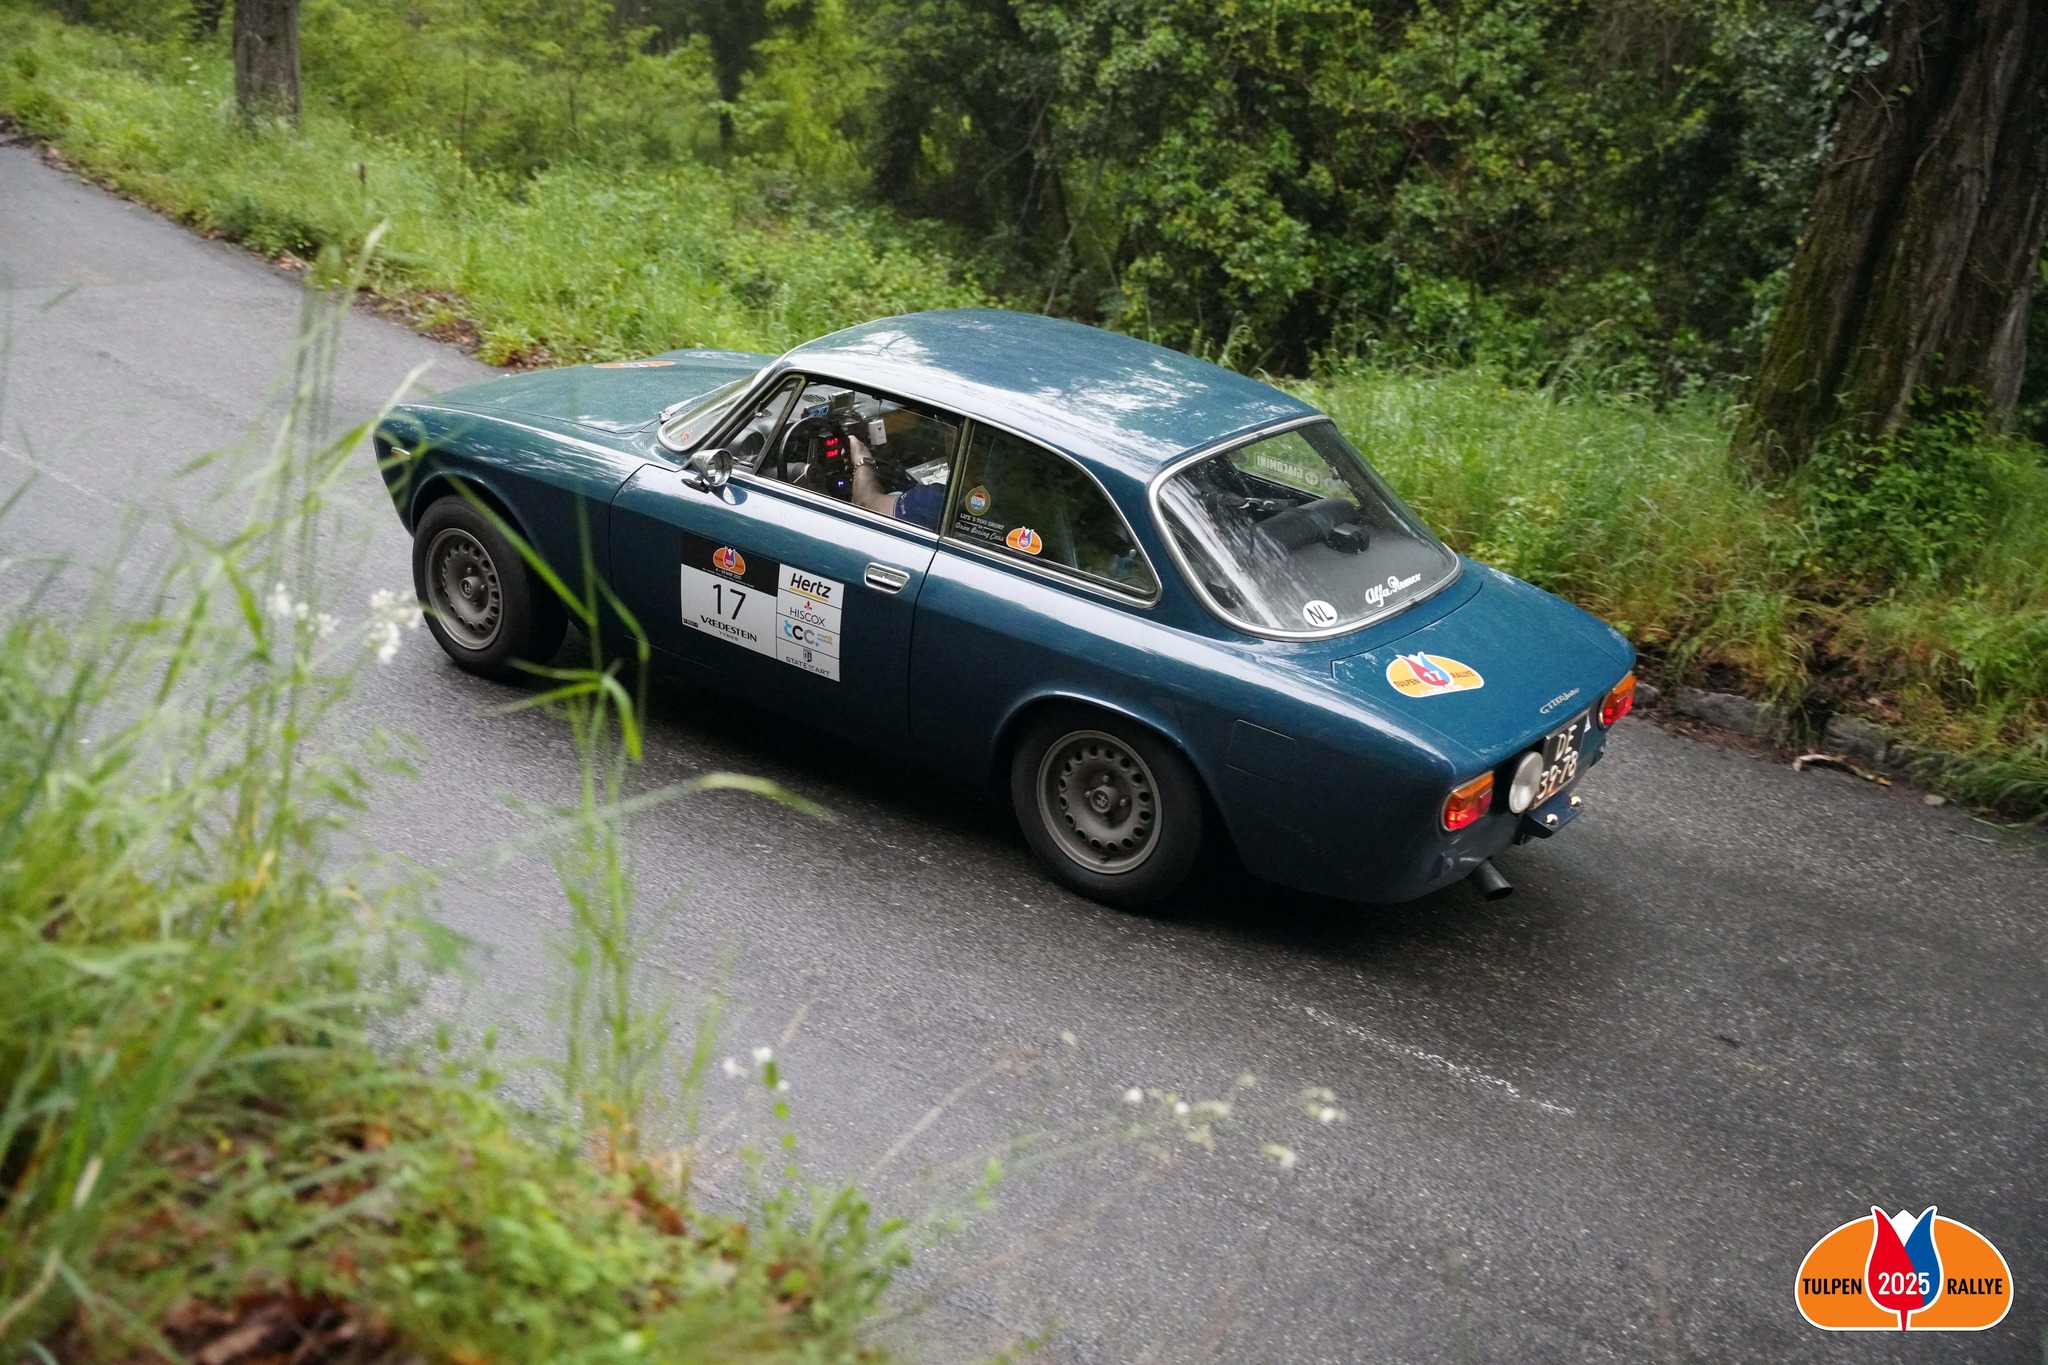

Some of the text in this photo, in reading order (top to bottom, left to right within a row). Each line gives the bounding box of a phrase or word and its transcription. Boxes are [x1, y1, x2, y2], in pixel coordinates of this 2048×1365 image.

[790, 573, 832, 598] Hertz
[1365, 573, 1421, 607] Alfa Romeo
[713, 584, 747, 620] 17
[1306, 604, 1334, 625] NL
[700, 614, 757, 642] VREDESTEIN
[790, 607, 826, 627] HISCOX
[785, 656, 808, 669] STATE
[815, 666, 830, 677] ART
[1393, 670, 1475, 688] TULPEN 17 RALLYE
[1555, 724, 1578, 762] DE
[1536, 750, 1579, 800] 39-78
